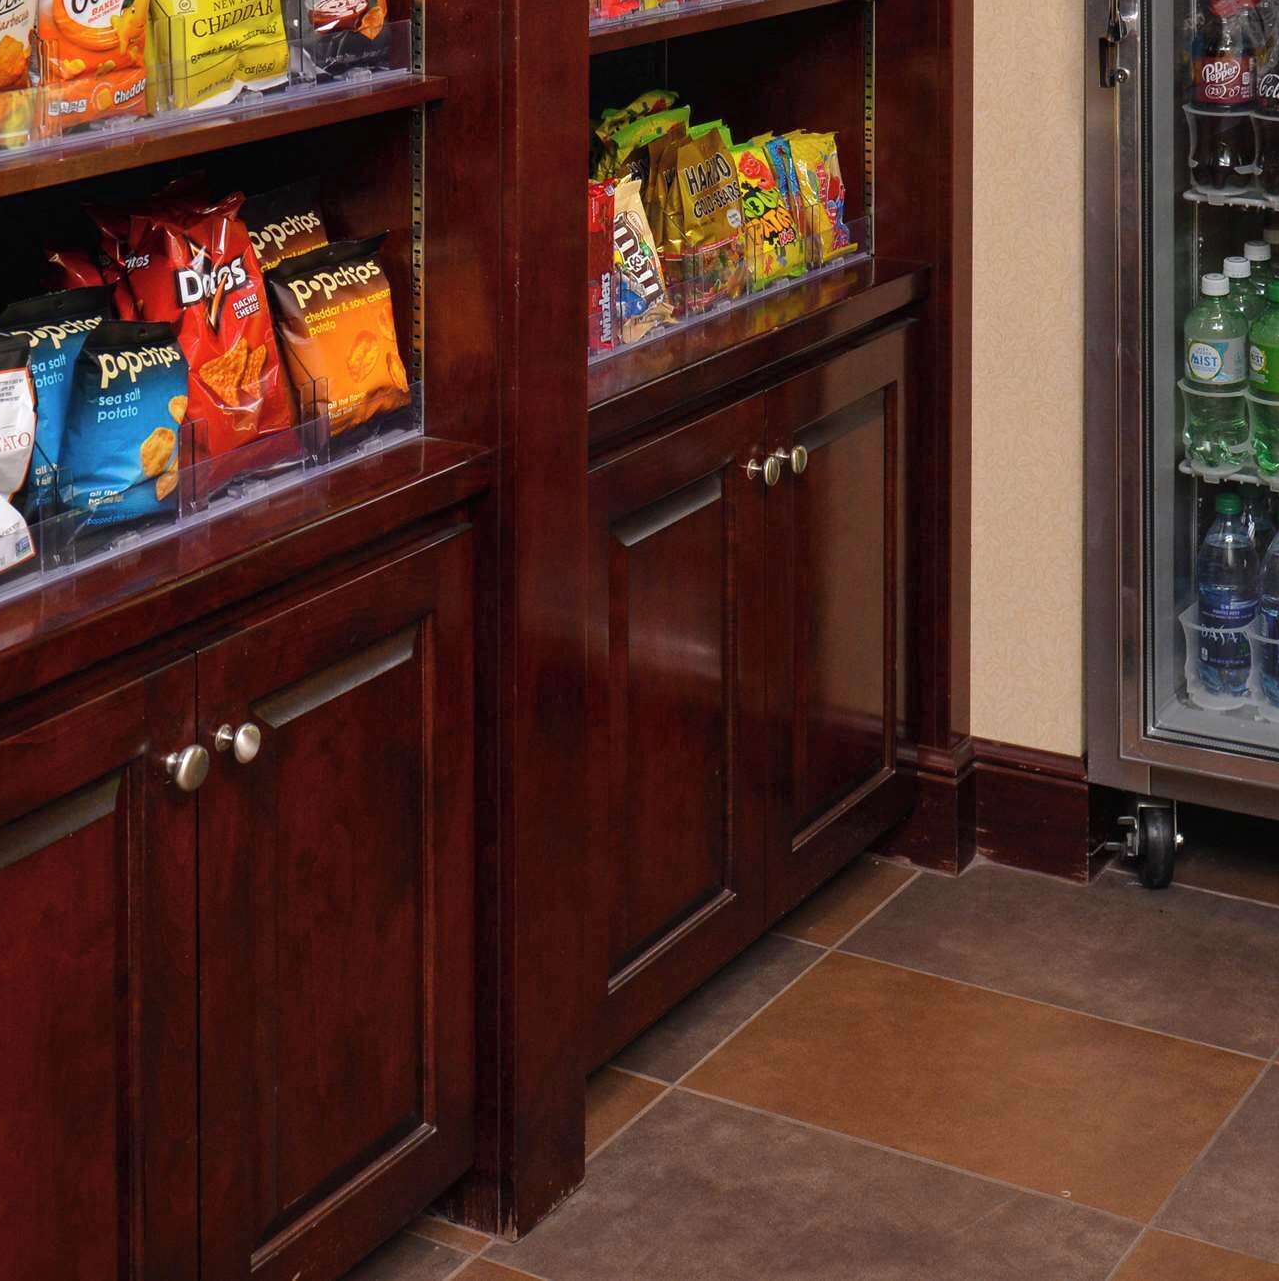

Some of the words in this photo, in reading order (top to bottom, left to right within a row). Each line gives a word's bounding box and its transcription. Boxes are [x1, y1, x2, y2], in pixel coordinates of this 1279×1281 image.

[1205, 64, 1238, 83] Pepper
[685, 152, 733, 196] HARIBO
[287, 260, 382, 310] popchips
[232, 293, 259, 311] NACHO
[235, 302, 261, 320] CHEESE
[303, 303, 341, 325] cheddar
[308, 321, 337, 340] potato
[49, 354, 66, 370] salt
[98, 344, 181, 388] popchips
[98, 393, 122, 406] sea
[123, 388, 141, 402] salt
[97, 405, 139, 423] potato
